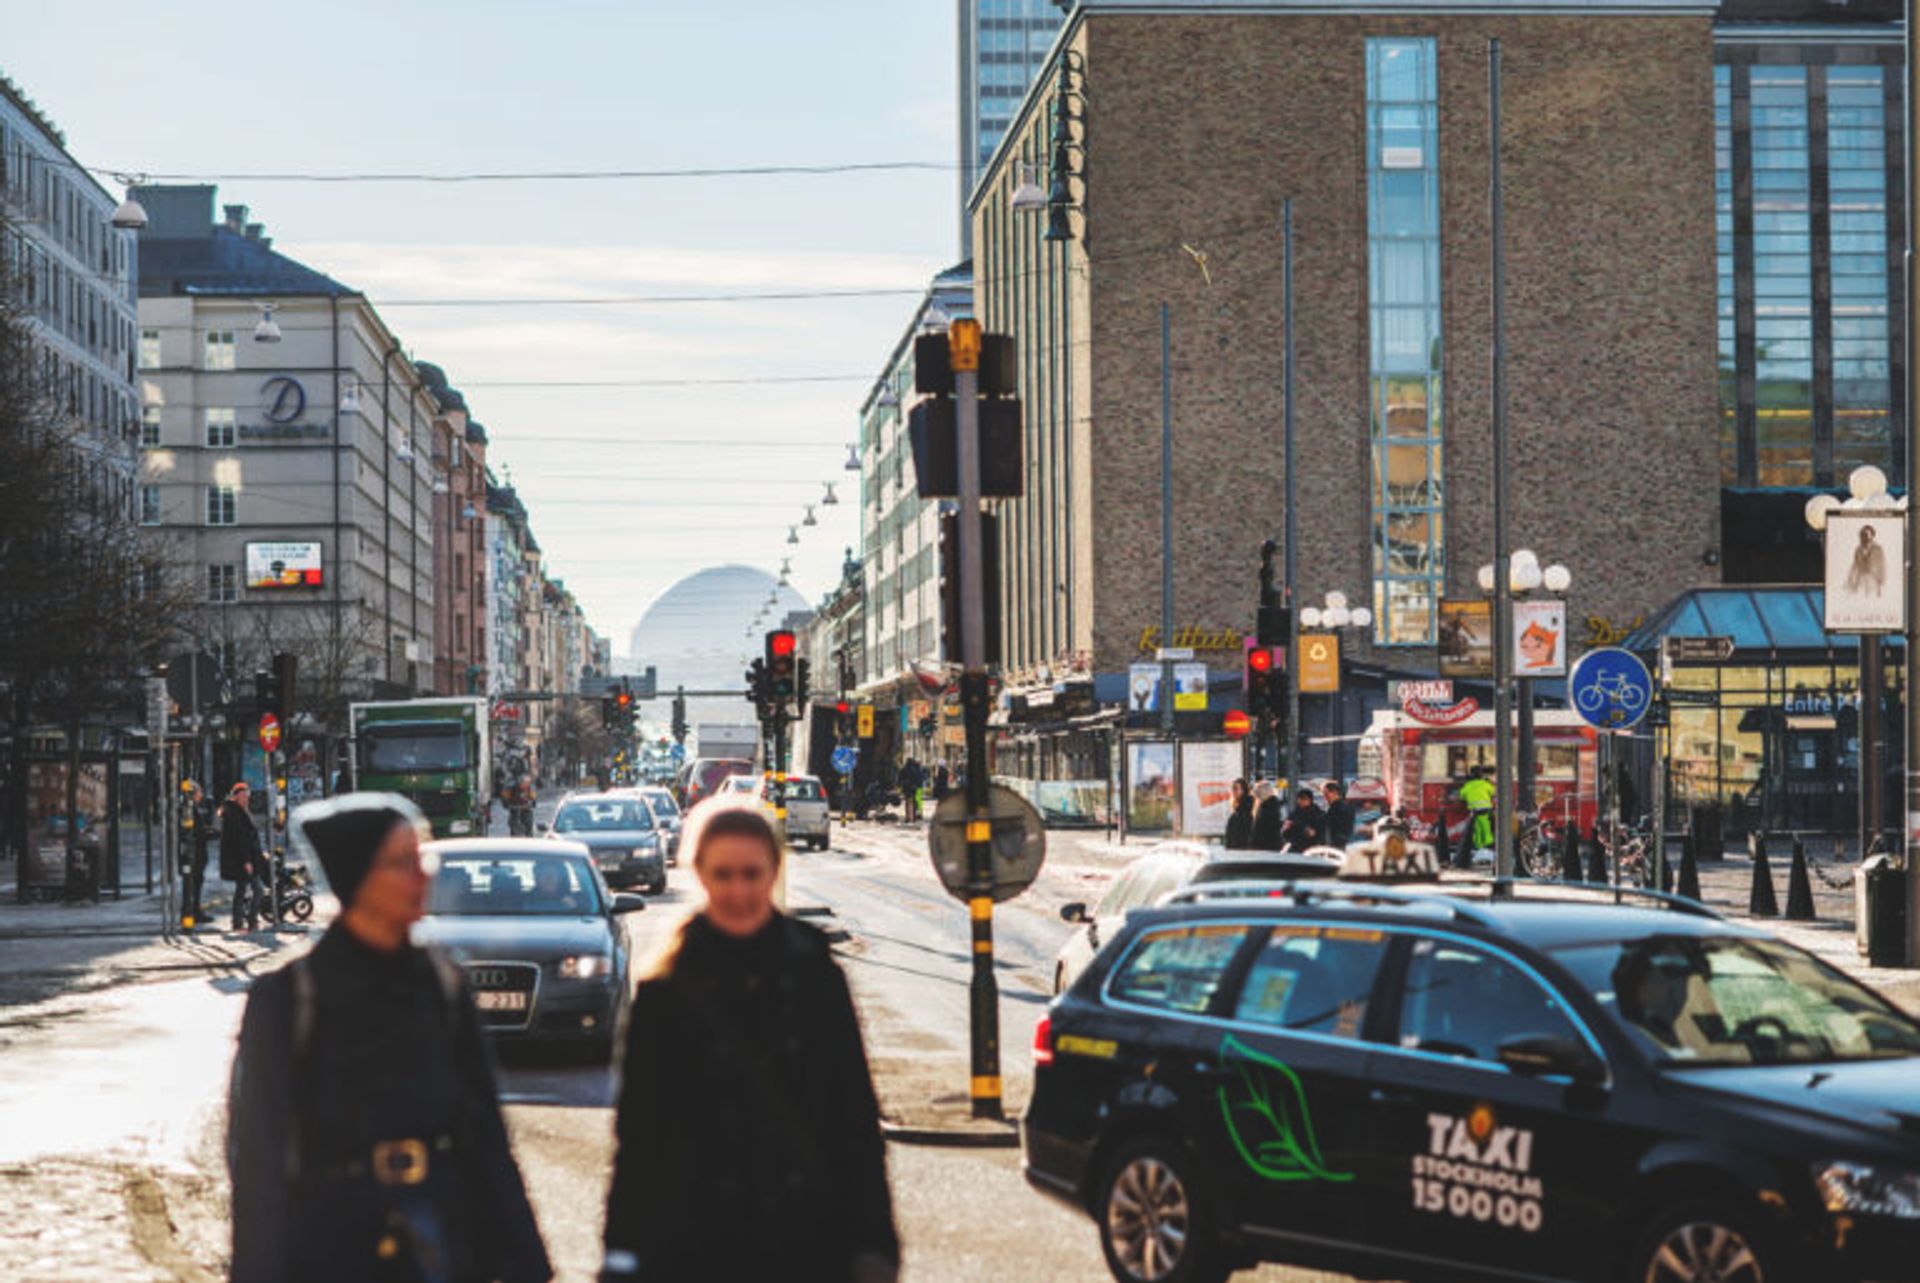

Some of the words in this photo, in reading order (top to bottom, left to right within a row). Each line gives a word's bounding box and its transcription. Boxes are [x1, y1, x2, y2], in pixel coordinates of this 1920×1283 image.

[260, 377, 306, 423] D
[1362, 849, 1432, 876] TAXI
[1427, 1112, 1533, 1172] TAXI
[1412, 1155, 1543, 1198] STOCKHOLM
